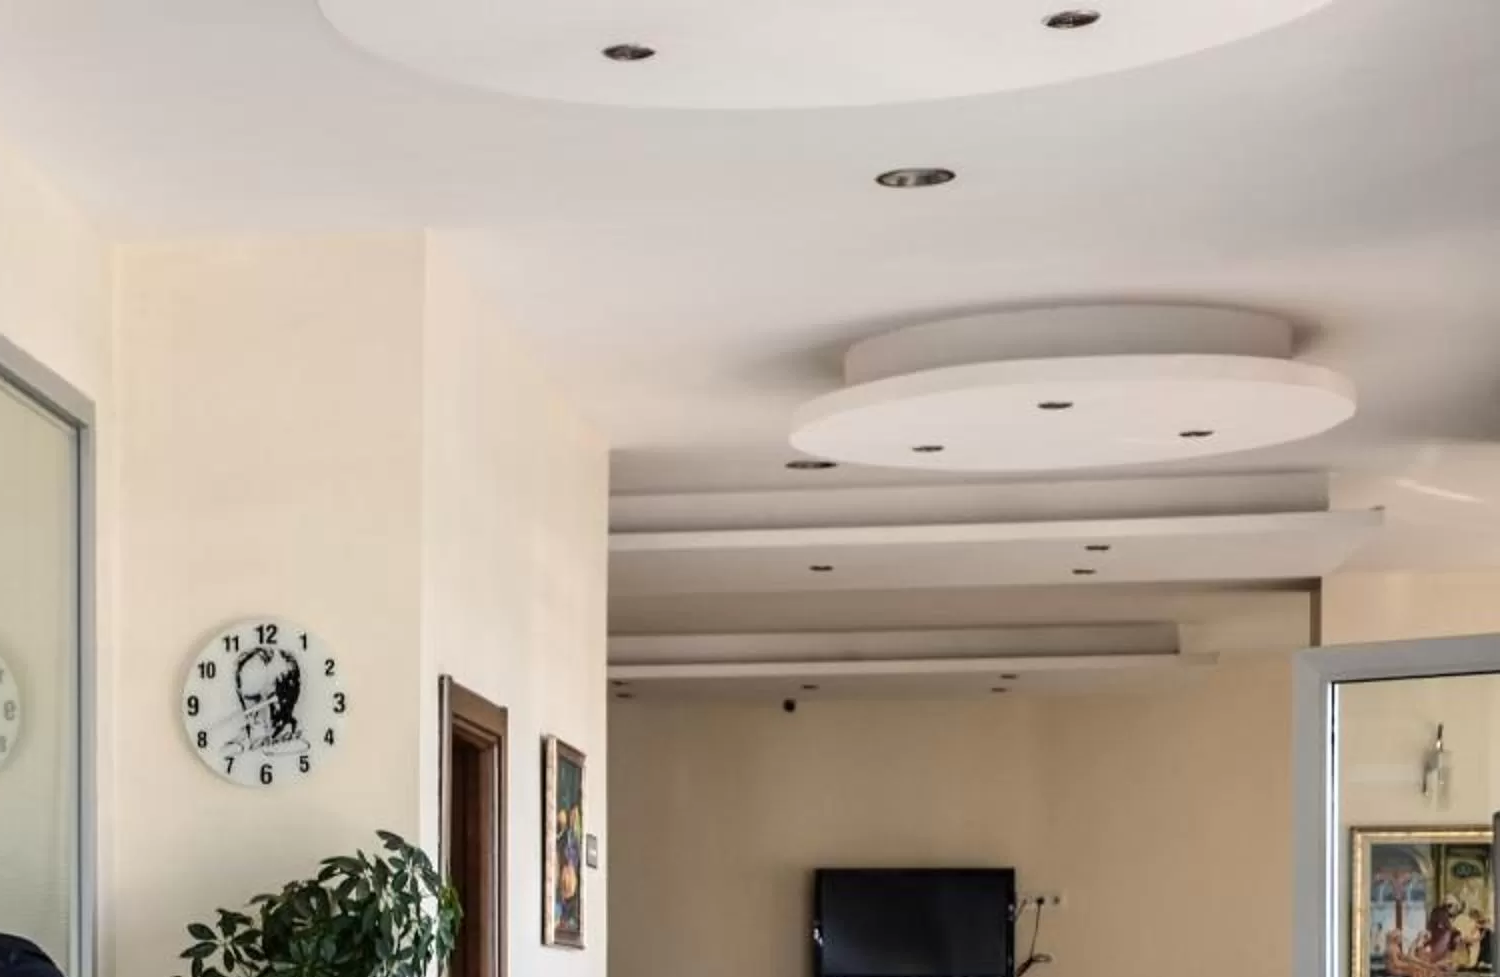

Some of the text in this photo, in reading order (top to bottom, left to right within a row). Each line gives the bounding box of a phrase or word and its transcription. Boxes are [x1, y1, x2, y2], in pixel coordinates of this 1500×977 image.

[255, 624, 277, 644] 12
[299, 633, 307, 650] 1
[223, 635, 239, 652] 11
[198, 661, 216, 678] 10
[325, 659, 335, 676] 2
[187, 696, 199, 716] 9
[333, 692, 346, 713] 3
[197, 731, 207, 748] 8
[324, 728, 334, 745] 4
[225, 757, 235, 774] 7
[300, 756, 310, 773] 5
[260, 764, 273, 784] 6
